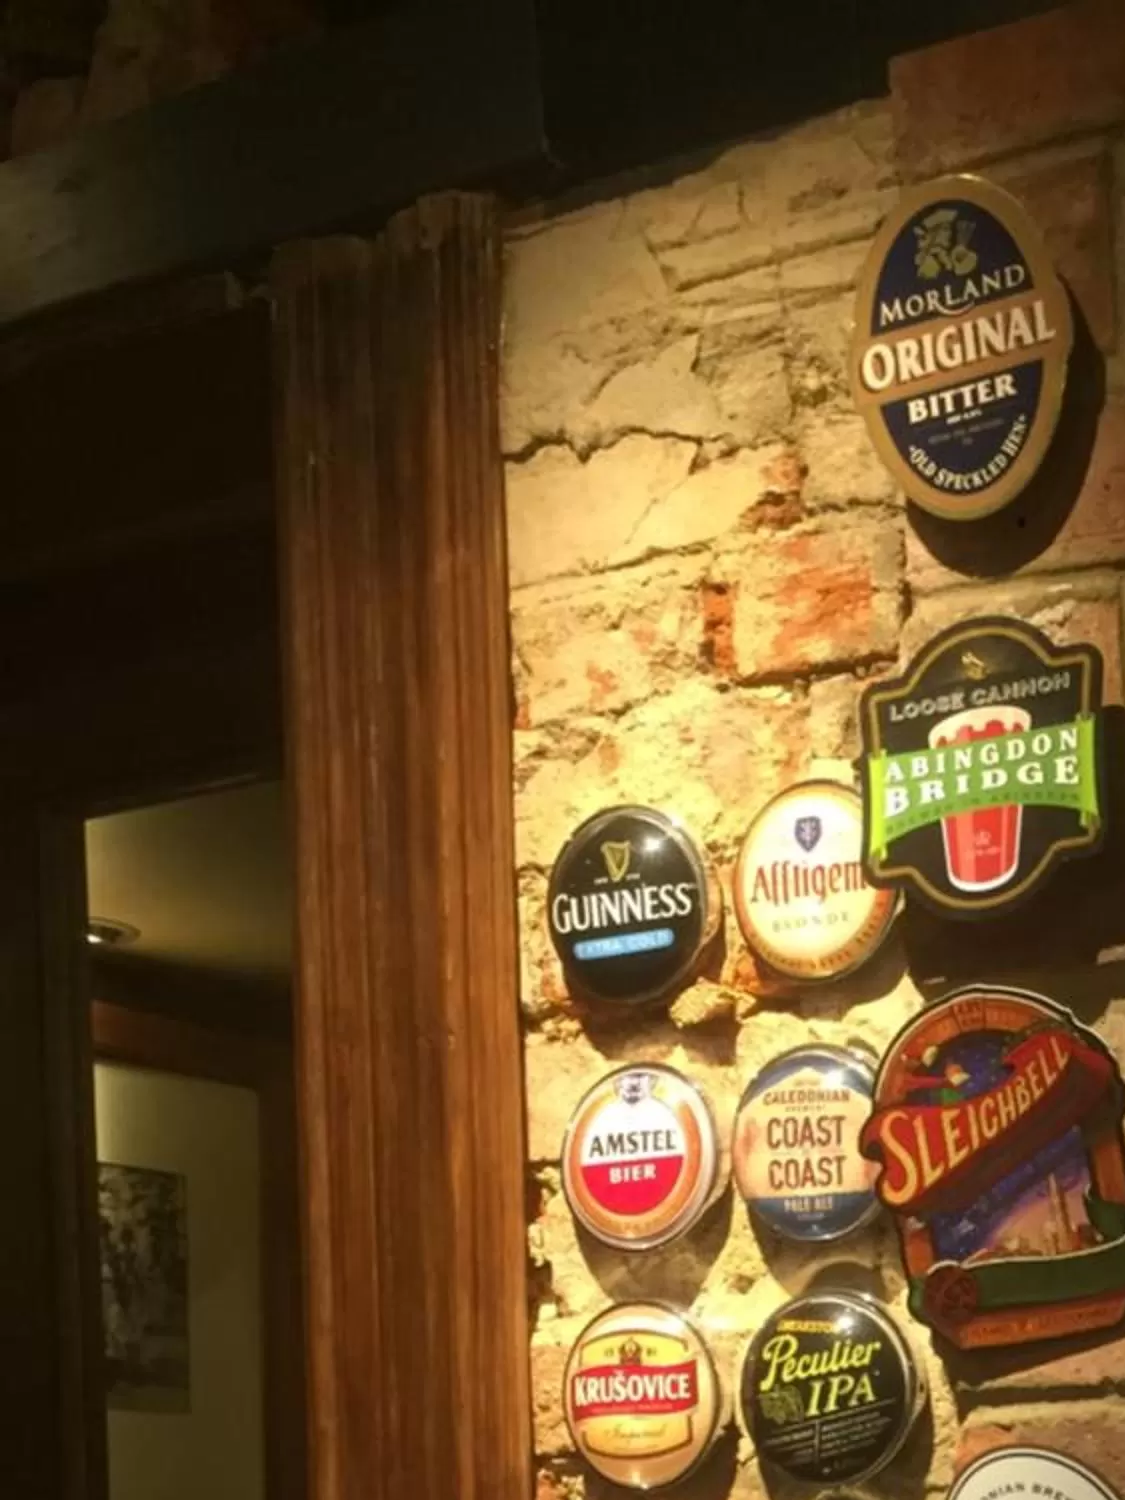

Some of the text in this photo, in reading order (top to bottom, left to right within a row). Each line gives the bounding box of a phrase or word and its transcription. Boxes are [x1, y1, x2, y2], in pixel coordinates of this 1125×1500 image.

[880, 264, 1025, 327] MORLAND
[861, 301, 1056, 391] ORIGINAL
[908, 373, 1018, 424] BITTER
[933, 451, 1008, 491] SPECKLED
[890, 672, 1070, 722] LOOSE CANNON
[884, 728, 1078, 784] ABINGDON
[883, 755, 1079, 818] BRIDGE
[552, 882, 693, 934] GUINNESS
[763, 1088, 851, 1107] CALEDONIAN
[589, 1130, 676, 1158] AMSTEL
[767, 1115, 847, 1149] COAST
[609, 1164, 656, 1184] BIER
[768, 1155, 847, 1190] COAST
[759, 1334, 881, 1392] Peculier
[574, 1369, 691, 1407] KRUŠOVICE
[808, 1373, 878, 1418] IPA
